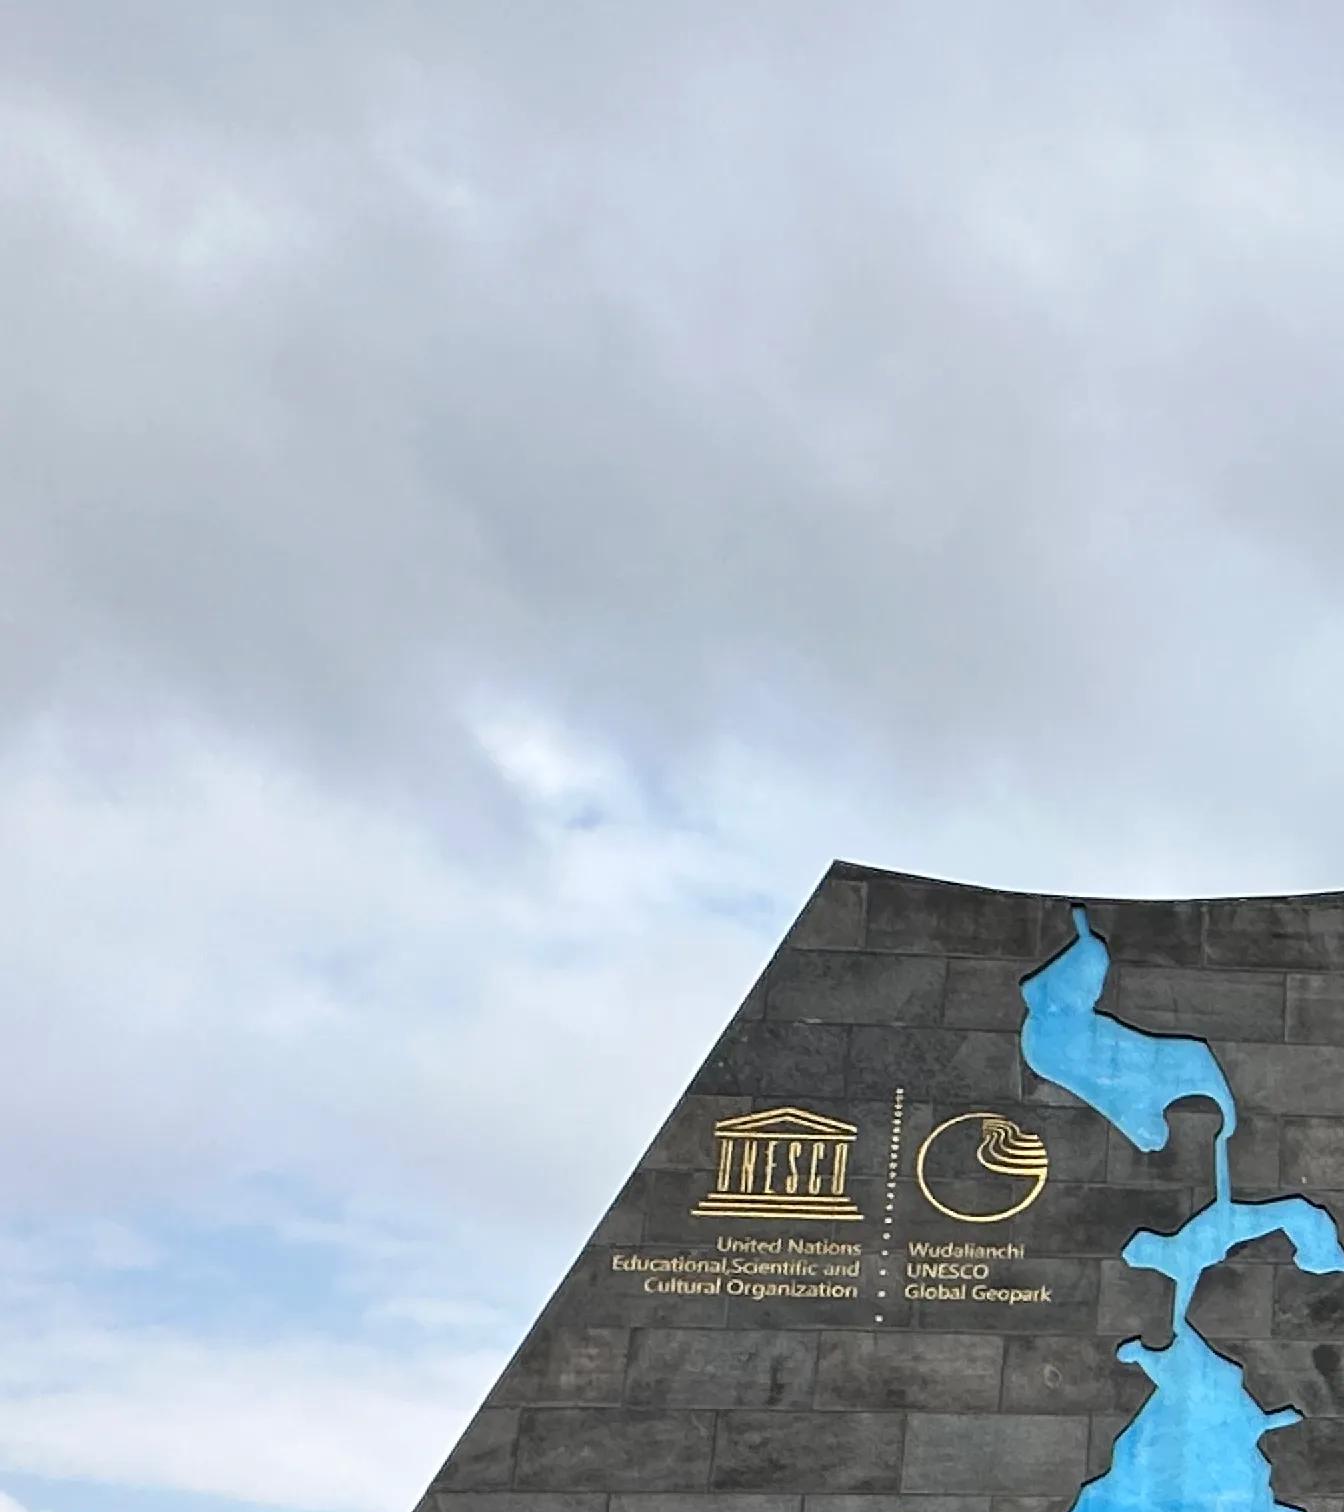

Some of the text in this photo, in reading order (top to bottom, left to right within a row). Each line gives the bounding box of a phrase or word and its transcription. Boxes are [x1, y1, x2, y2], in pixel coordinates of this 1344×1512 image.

[716, 1138, 850, 1196] UNESCO
[716, 1236, 862, 1256] United Nations
[908, 1242, 1025, 1260] Wudalianchi
[823, 1260, 860, 1278] and
[906, 1262, 990, 1280] UNESCO
[643, 1276, 859, 1300] Cultural Organization
[904, 1282, 1052, 1305] Global Geopark
